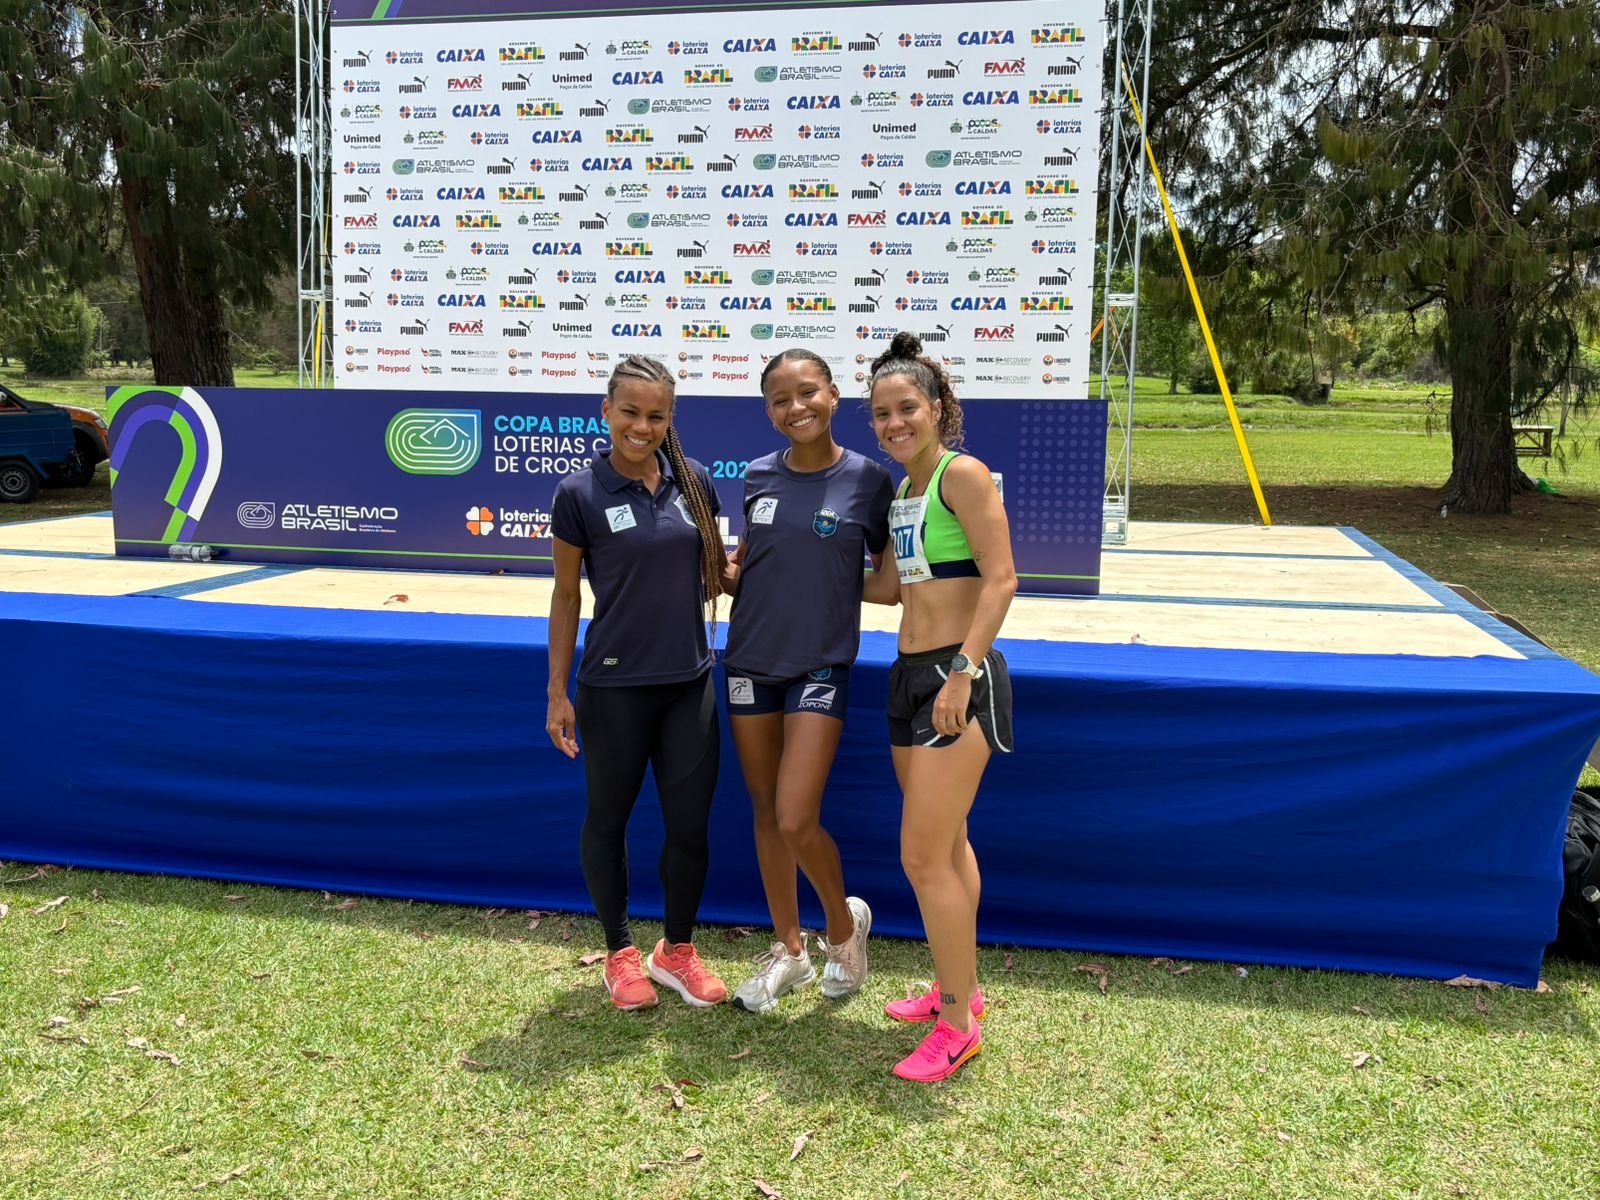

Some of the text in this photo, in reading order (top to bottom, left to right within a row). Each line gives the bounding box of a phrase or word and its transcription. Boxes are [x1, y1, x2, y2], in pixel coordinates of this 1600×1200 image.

[957, 30, 1014, 45] CAIXA
[1031, 28, 1085, 44] BRASIL
[723, 38, 776, 53] CAIXA
[792, 36, 842, 51] BRASIL
[848, 41, 875, 51] PUMA
[436, 49, 485, 63] CAIXA
[499, 47, 545, 61] BRASIL
[683, 47, 708, 55] CAIXA
[343, 58, 366, 67] PUMA
[780, 65, 842, 75] ATLETISMO
[928, 69, 955, 79] PUMA
[1048, 65, 1076, 75] PUMA
[552, 73, 592, 83] Unimed
[612, 71, 663, 85] CAIXA
[684, 69, 733, 84] BRASIL
[399, 84, 422, 94] PUMA
[963, 90, 1019, 105] CAIXA
[1029, 89, 1083, 104] BRASIL
[652, 98, 712, 107] ATLETISMO
[787, 95, 840, 110] CAIXA
[926, 99, 953, 107] CAIXA
[413, 105, 436, 113] loterias
[452, 104, 501, 118] CAIXA
[517, 102, 563, 117] BRASIL
[651, 105, 690, 113] BRASIL
[814, 125, 840, 133] loterias
[873, 123, 916, 133] Unimed
[343, 134, 381, 143] Unimed
[532, 130, 582, 144] CAIXA
[606, 129, 654, 143] BRASIL
[678, 134, 703, 143] PUMA
[814, 131, 840, 139] CAIXA
[778, 154, 840, 162] ATLETISMO
[954, 150, 1022, 158] ATLETISMO
[417, 159, 475, 168] ATLETISMO
[582, 158, 632, 171] CAIXA
[646, 157, 694, 171] BRASIL
[778, 160, 818, 168] BRASIL
[953, 157, 998, 166] BRASIL
[1044, 156, 1072, 166] PUMA
[357, 166, 380, 174] CAIXA
[487, 165, 511, 174] PUMA
[721, 184, 774, 198] CAIXA
[789, 184, 839, 198] BRASIL
[955, 181, 1011, 195] CAIXA
[1025, 180, 1079, 195] BRASIL
[344, 194, 367, 203] PUMA
[437, 187, 485, 200] CAIXA
[499, 187, 545, 200] BRASIL
[852, 190, 878, 199] PUMA
[393, 215, 440, 227] CAIXA
[456, 215, 501, 228] BRASIL
[651, 219, 690, 227] BRASIL
[785, 213, 838, 226] CAIXA
[896, 212, 951, 225] CAIXA
[961, 211, 1013, 225] BRASIL
[580, 221, 604, 229] PUMA
[532, 242, 582, 255] CAIXA
[606, 242, 653, 256] BRASIL
[886, 241, 912, 250] loterias
[885, 247, 912, 255] CAIXA
[344, 275, 367, 283] PUMA
[508, 276, 532, 284] PUMA
[615, 270, 666, 283] CAIXA
[684, 271, 732, 284] BRASIL
[1039, 276, 1067, 285] PUMA
[345, 299, 368, 308] PUMA
[437, 294, 486, 307] CAIXA
[500, 295, 545, 308] BRASIL
[681, 296, 705, 304] loterias
[720, 297, 772, 310] CAIXA
[787, 297, 836, 311] BRASIL
[951, 297, 1006, 310] CAIXA
[1020, 297, 1073, 311] BRASIL
[681, 302, 705, 310] CAIXA
[849, 304, 875, 313] PUMA
[359, 325, 382, 333] CAIXA
[400, 326, 424, 335] PUMA
[503, 328, 527, 337] PUMA
[553, 323, 592, 332] Unimed
[612, 324, 662, 337] CAIXA
[682, 325, 730, 338] BRASIL
[775, 325, 836, 333] ATLETISMO
[775, 331, 814, 339] BRASIL
[1036, 333, 1064, 342] PUMA
[377, 347, 411, 357] Playpiso
[542, 351, 577, 360] Playpiso
[713, 354, 749, 363] Playpiso
[377, 364, 411, 374] Playpiso
[542, 368, 576, 378] Playpiso
[712, 371, 749, 381] Playpiso
[494, 415, 610, 434] COPA BRAS
[494, 436, 586, 454] LOTERIAS
[495, 456, 519, 473] DE
[713, 460, 750, 479] 202
[281, 504, 399, 519] ATLETISMO
[281, 518, 357, 532] BRASIL
